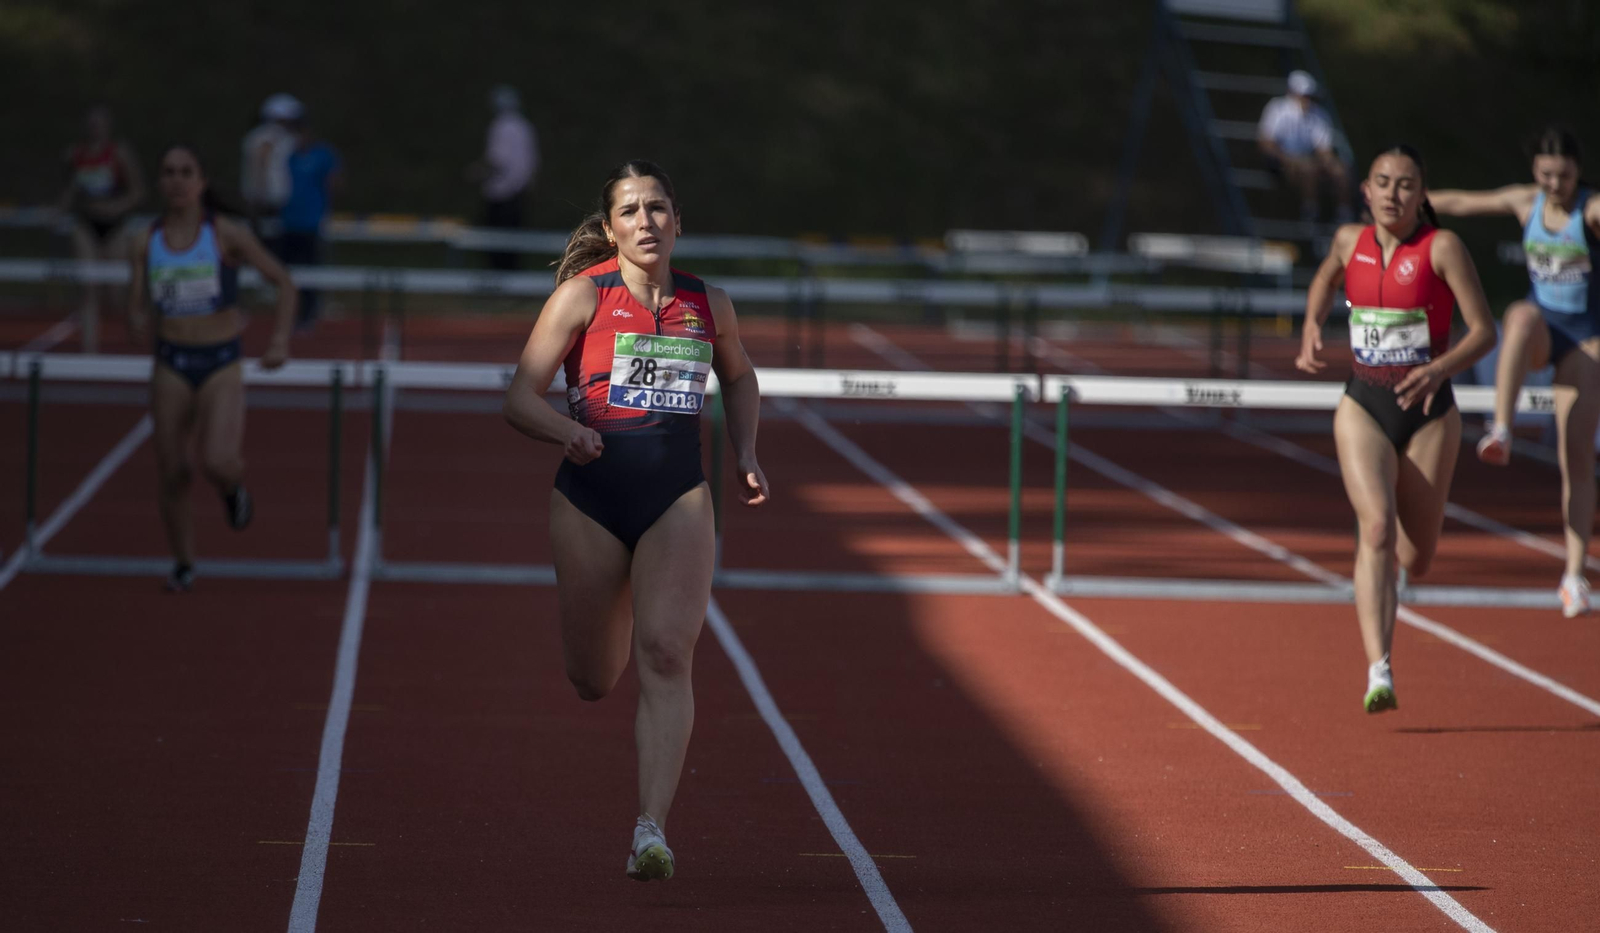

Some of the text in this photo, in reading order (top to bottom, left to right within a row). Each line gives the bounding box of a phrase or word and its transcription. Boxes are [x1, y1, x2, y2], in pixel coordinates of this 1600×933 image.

[1363, 328, 1380, 348] 19
[653, 342, 700, 357] Iberdrola
[628, 357, 658, 386] 28
